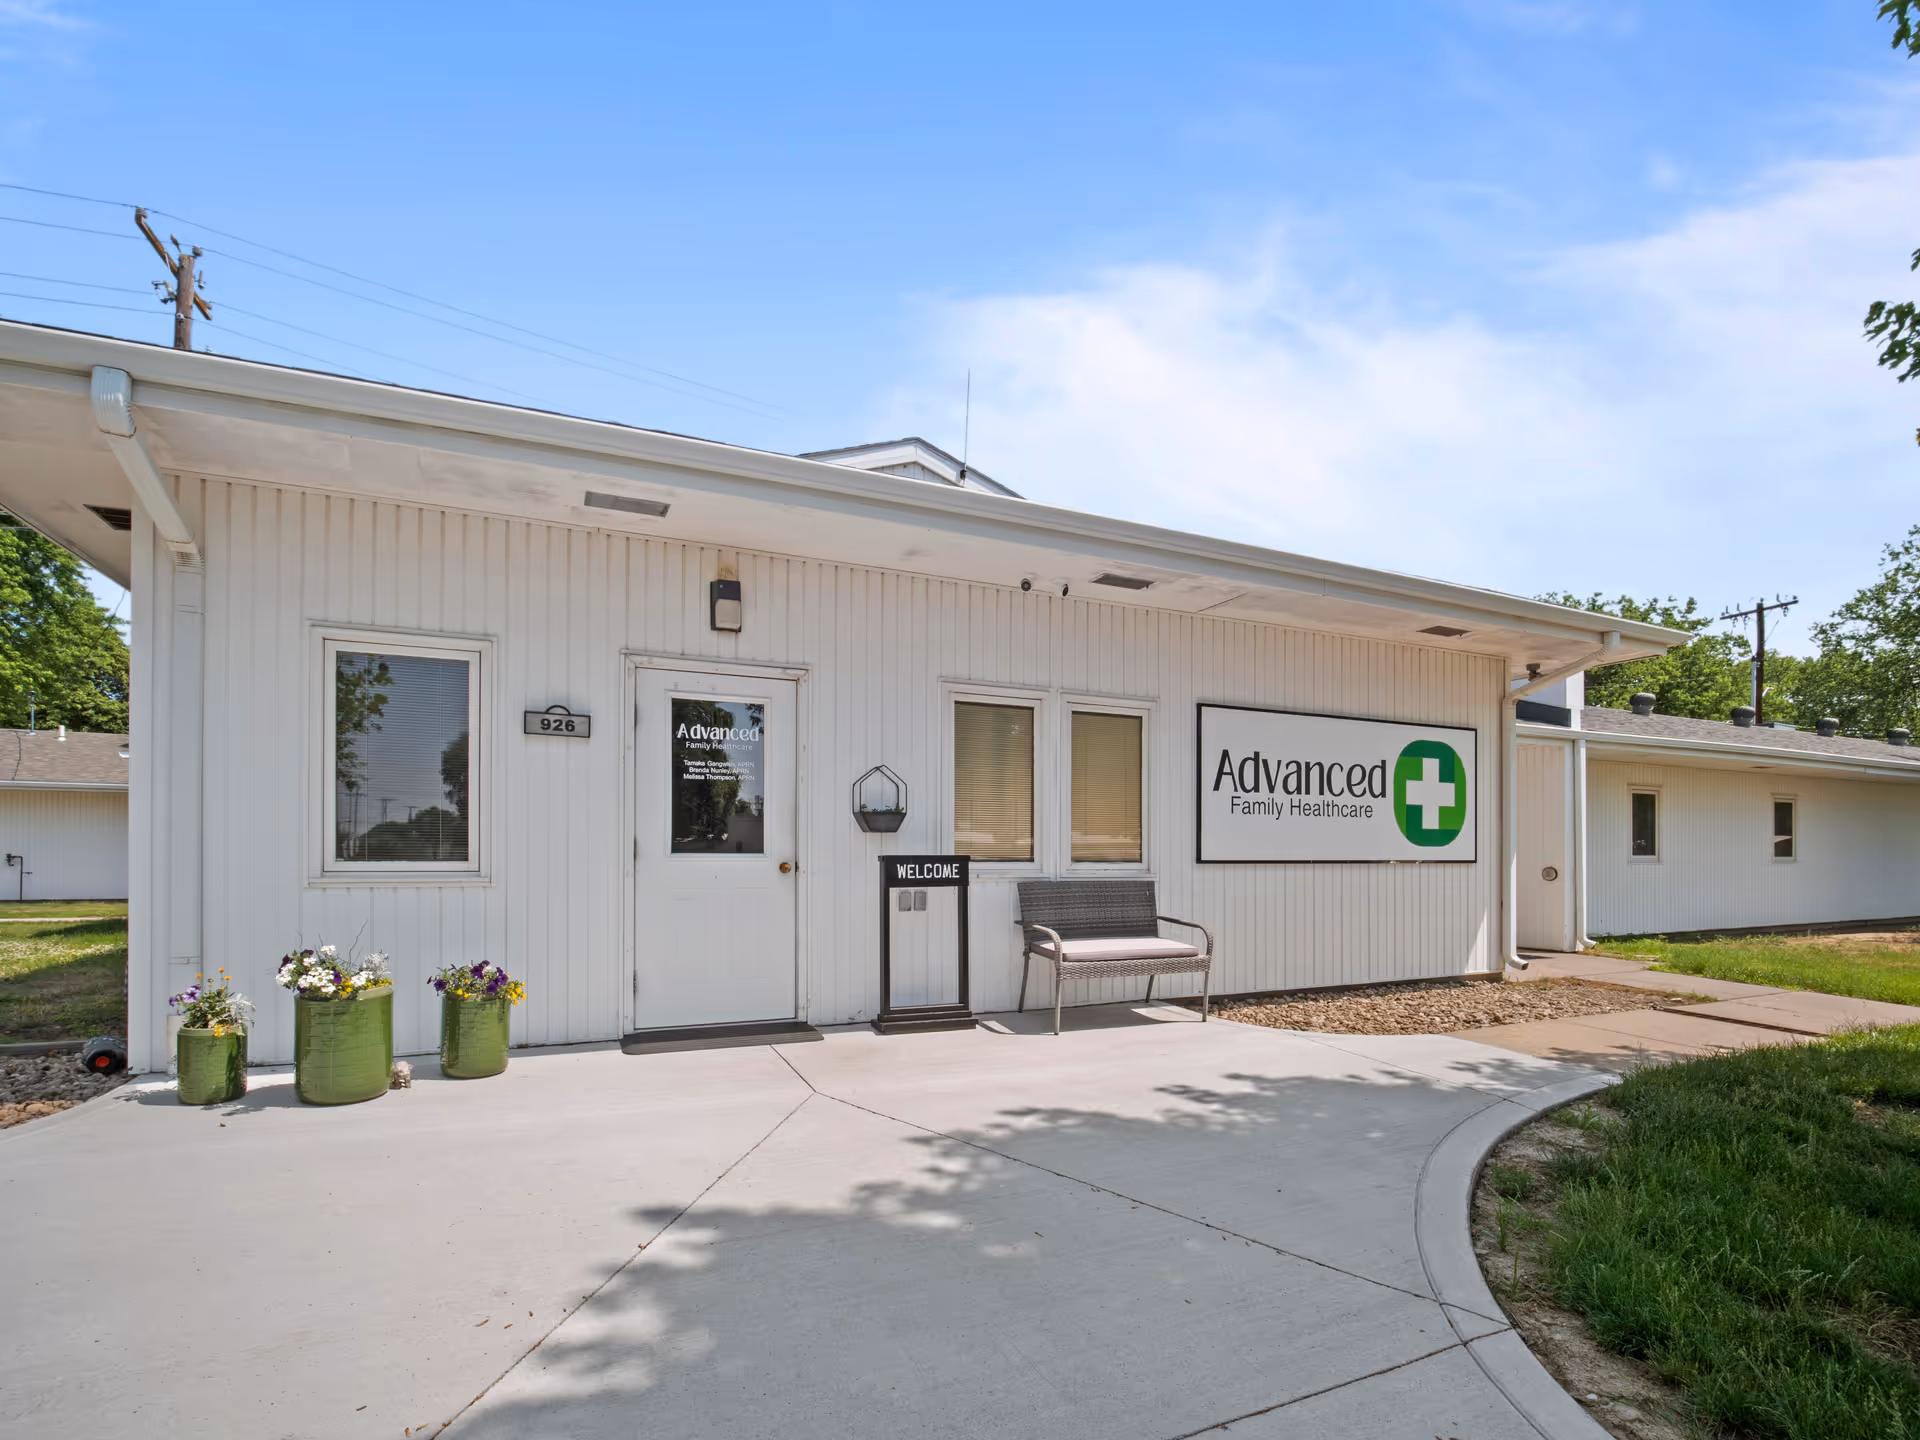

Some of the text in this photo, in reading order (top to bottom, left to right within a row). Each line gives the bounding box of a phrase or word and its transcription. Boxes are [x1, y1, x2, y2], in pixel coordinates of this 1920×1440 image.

[540, 718, 575, 732] 926
[677, 723, 759, 741] Advanced
[685, 741, 753, 751] Family Healthcare
[737, 761, 755, 769] APRN
[1213, 749, 1387, 798] Advanced
[1231, 796, 1373, 820] Family Healthcare
[896, 863, 960, 879] WELCOME
